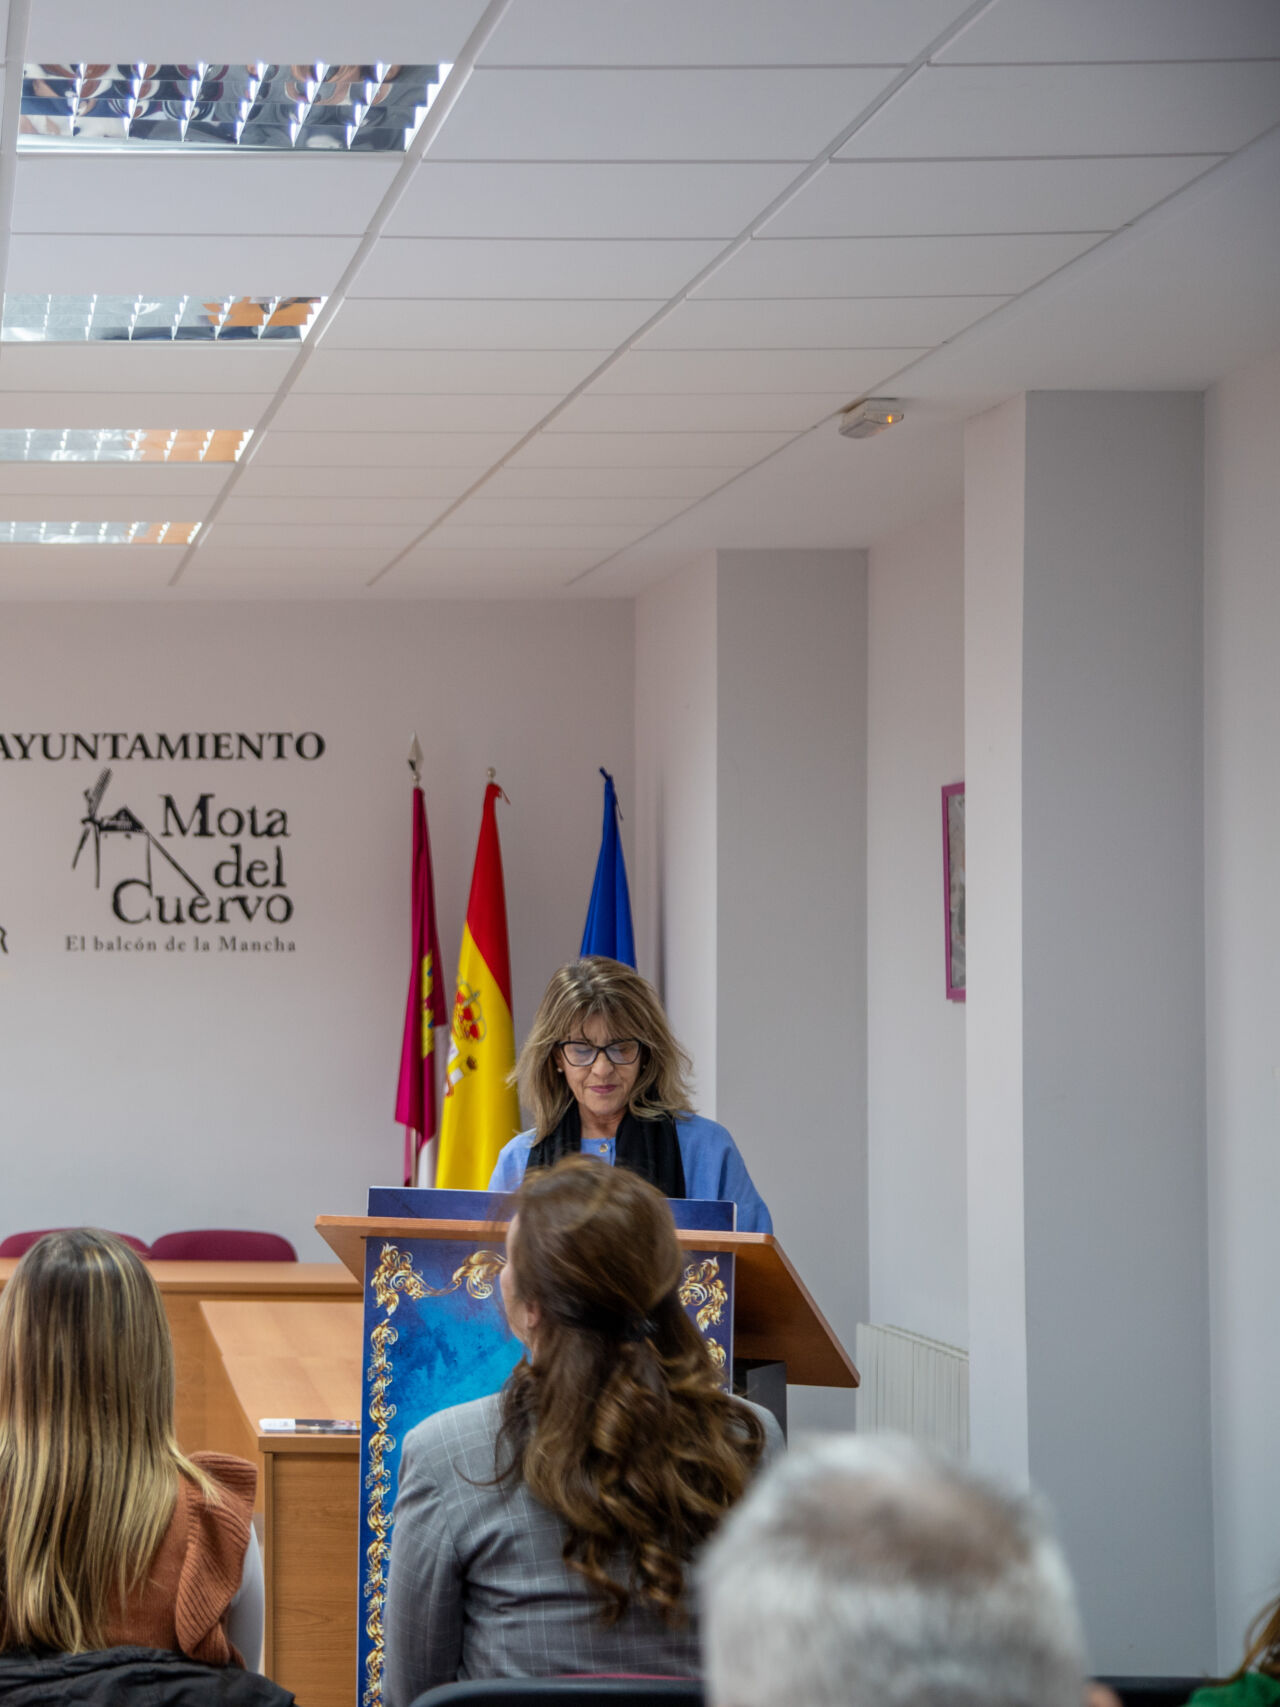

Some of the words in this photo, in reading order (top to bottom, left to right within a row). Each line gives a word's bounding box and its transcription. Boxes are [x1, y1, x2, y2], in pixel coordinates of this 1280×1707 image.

[160, 793, 290, 839] Mota
[213, 844, 287, 889] del
[111, 877, 294, 925] Cuervo
[65, 935, 86, 951] El
[93, 935, 157, 952] balcón
[164, 935, 186, 951] de
[194, 935, 211, 951] la
[219, 935, 296, 951] Mancha
